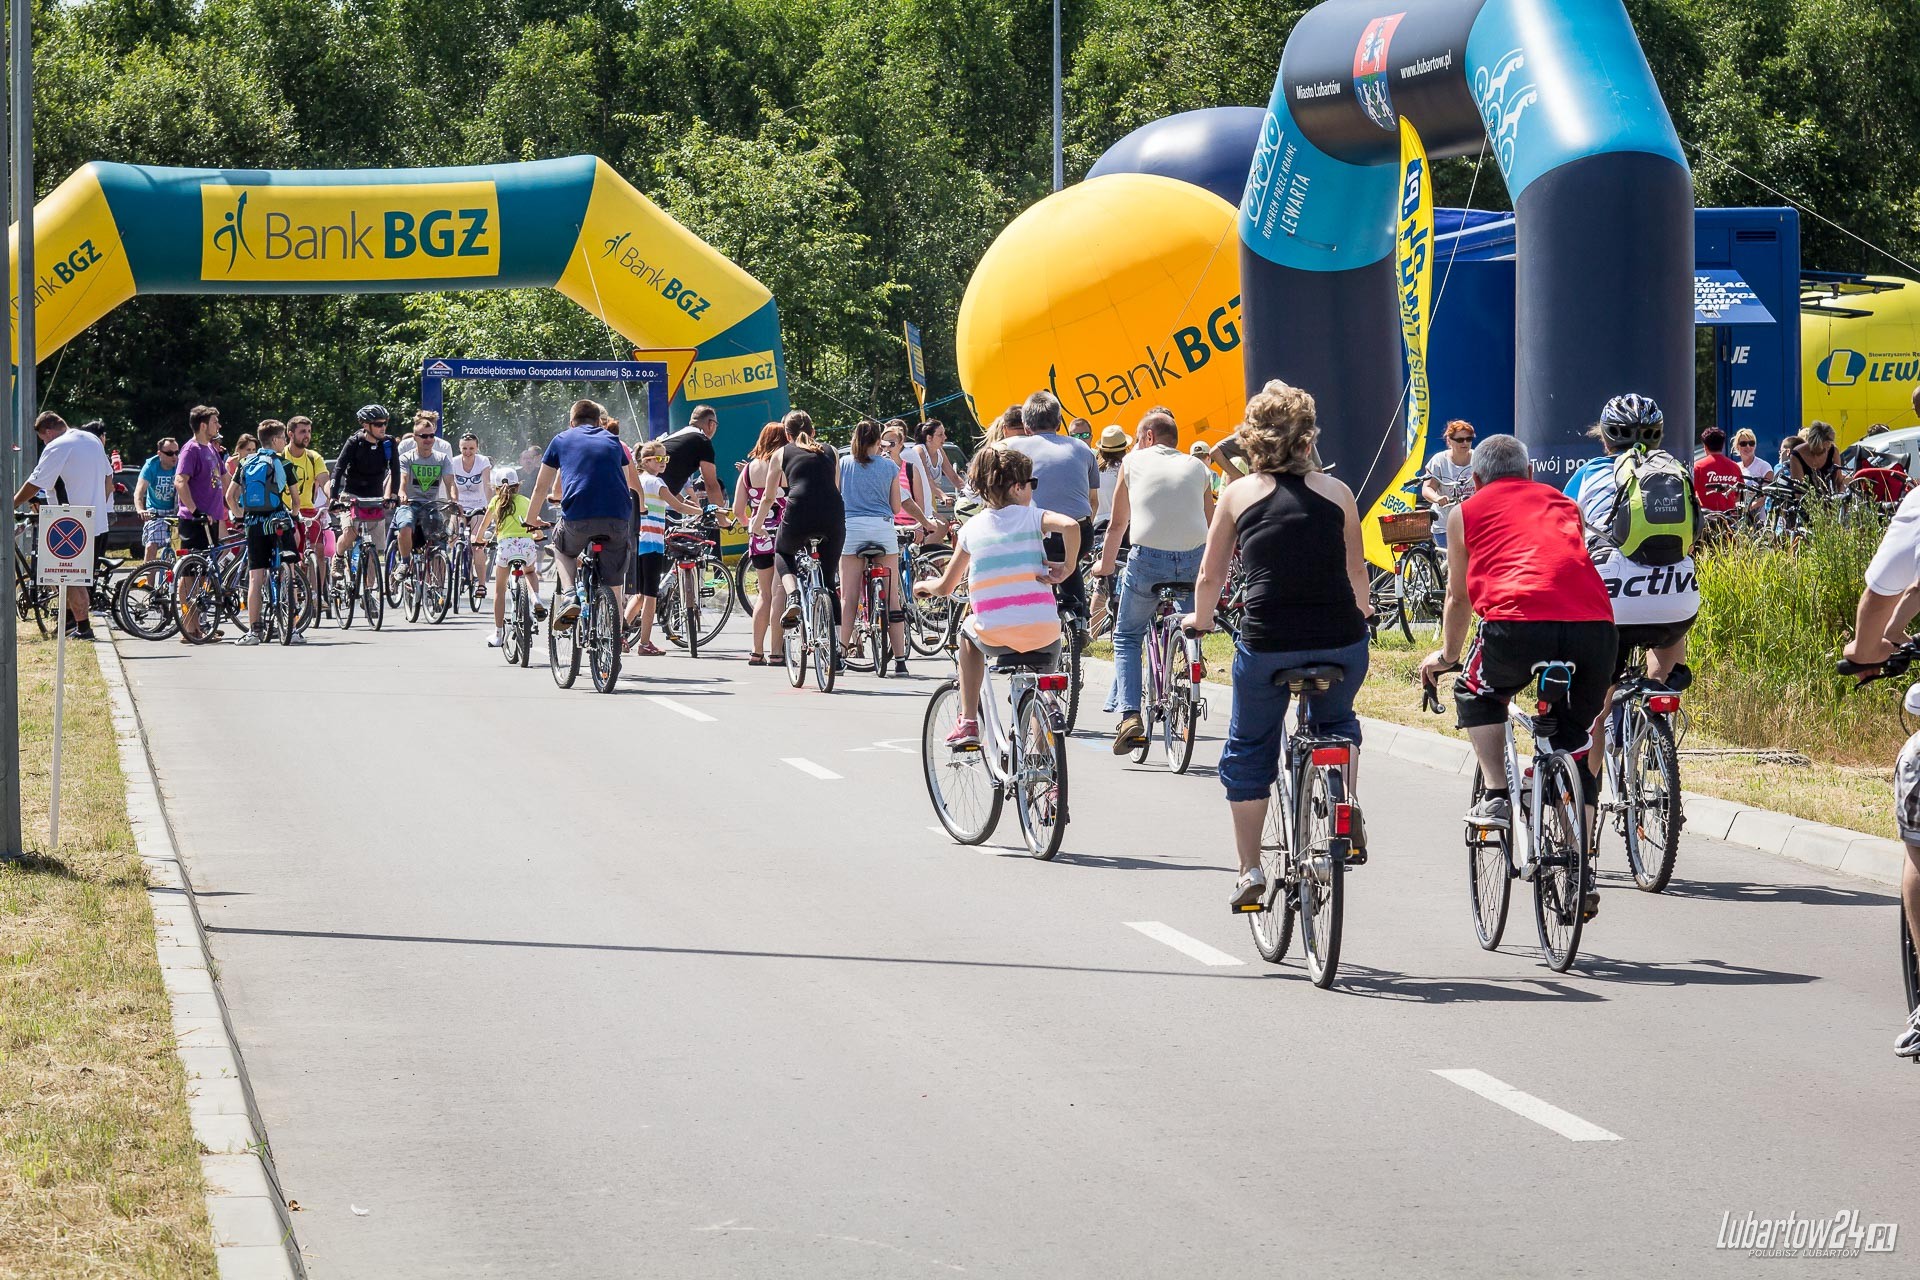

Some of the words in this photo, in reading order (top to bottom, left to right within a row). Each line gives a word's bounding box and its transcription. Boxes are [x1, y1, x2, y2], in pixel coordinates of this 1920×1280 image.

[1400, 49, 1452, 79] www.lubartow.pl
[1296, 85, 1314, 99] Miasto
[1314, 80, 1341, 97] Lubartów
[1262, 198, 1280, 240] ROWEREM
[1273, 172, 1288, 200] PRZEZ
[1280, 173, 1311, 235] LEWARTA
[266, 210, 375, 260] Bank
[619, 247, 666, 291] Bank
[461, 365, 527, 377] Przedsiębiorstwo
[528, 366, 572, 378] Gospodarki
[573, 367, 619, 379] Komunalnej
[620, 368, 634, 379] Sp.
[703, 369, 742, 389] Bank
[1075, 345, 1182, 416] Bank
[1868, 359, 1920, 382] LEW
[417, 466, 437, 477] EDGE
[1530, 455, 1560, 475] Twój
